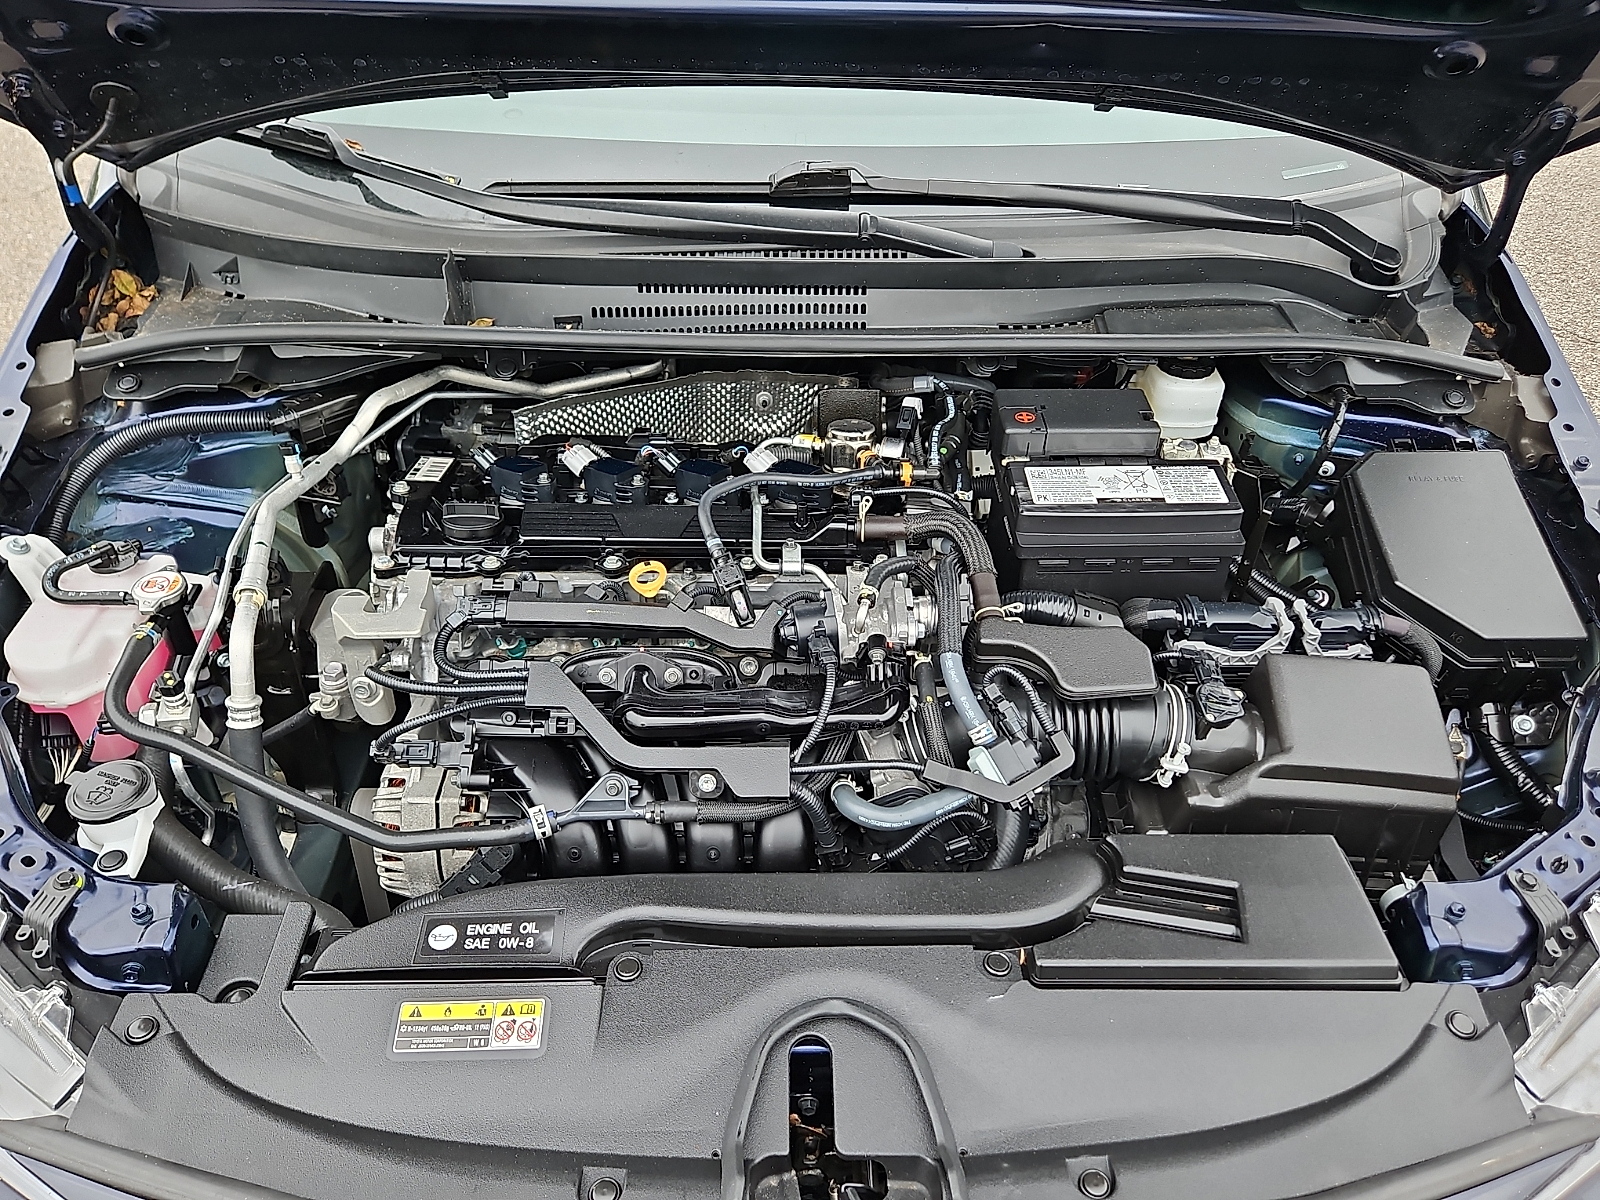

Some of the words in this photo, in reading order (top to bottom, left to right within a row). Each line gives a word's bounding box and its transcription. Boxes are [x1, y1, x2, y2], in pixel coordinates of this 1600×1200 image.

[466, 922, 513, 935] ENGINE
[519, 921, 540, 934] OIL
[464, 937, 490, 949] SAE
[498, 936, 534, 949] 0W-8
